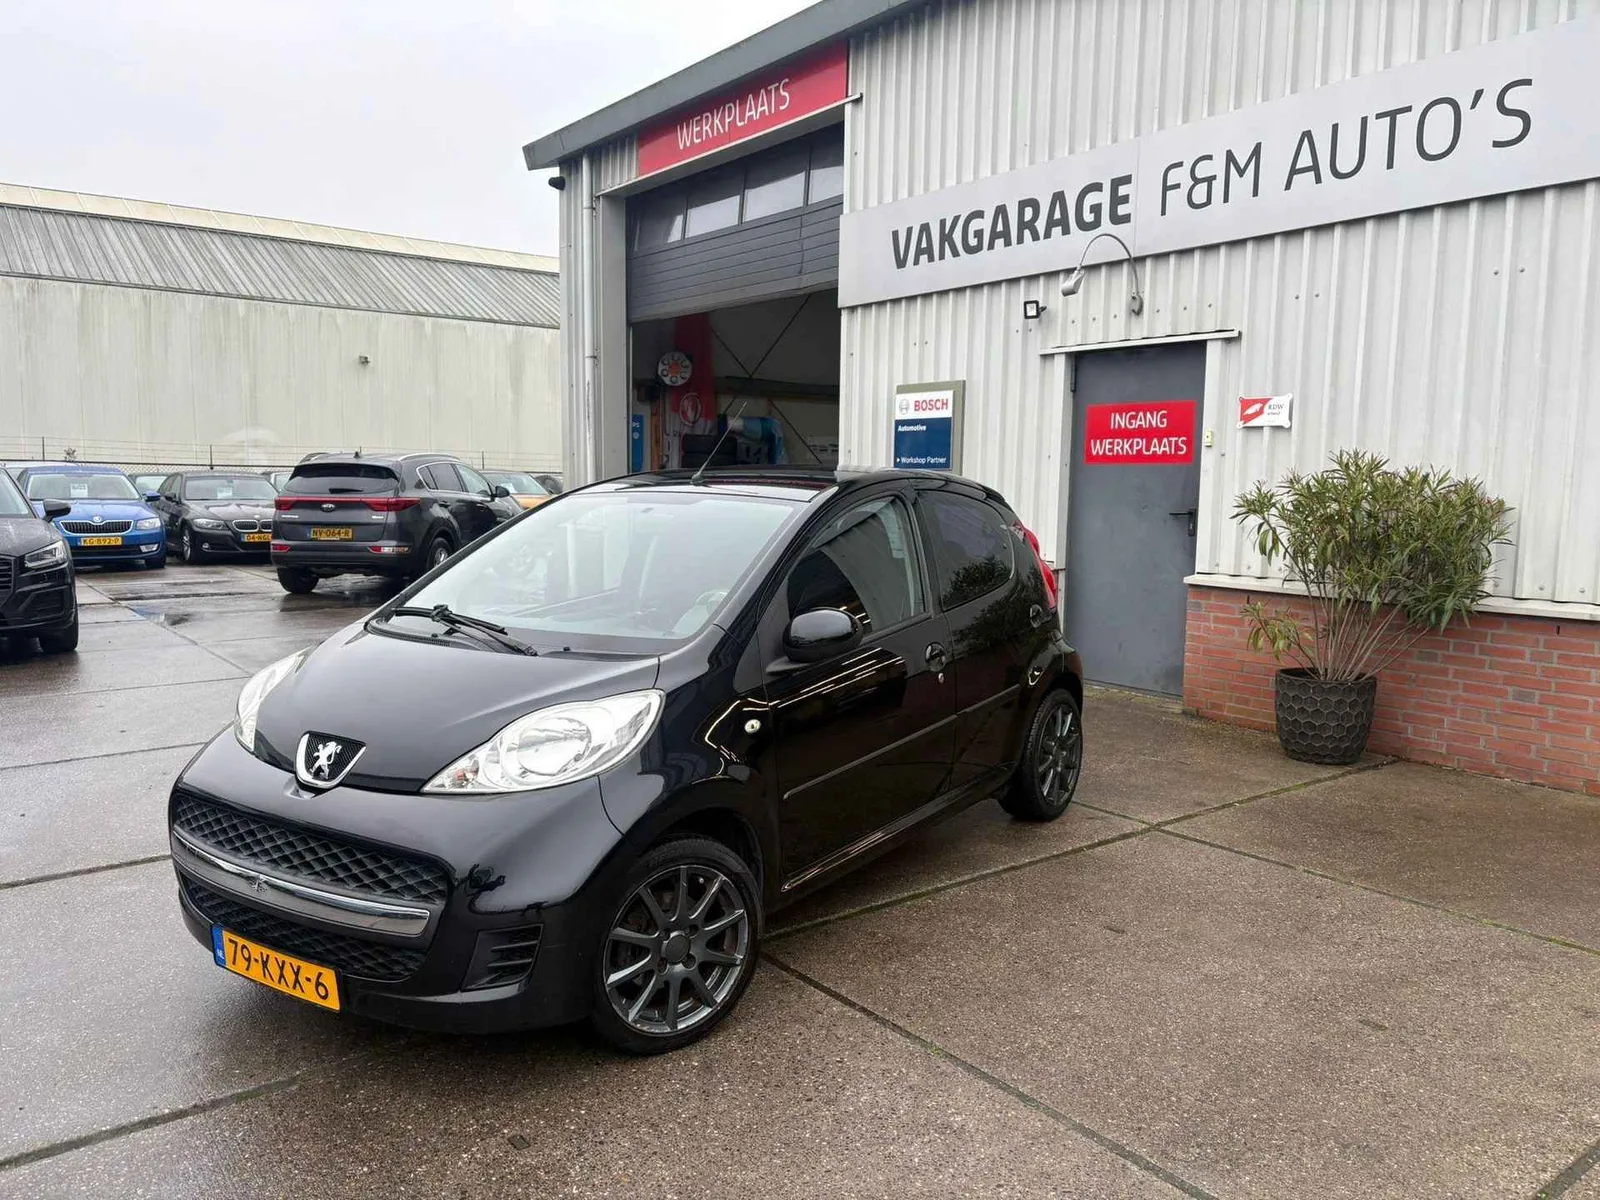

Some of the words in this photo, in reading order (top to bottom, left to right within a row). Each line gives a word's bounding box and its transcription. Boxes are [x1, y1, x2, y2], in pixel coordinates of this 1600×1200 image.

[677, 78, 790, 150] WERKPLAATS
[891, 173, 1133, 270] VAKGARAGE
[1160, 141, 1262, 217] F&M
[1284, 78, 1533, 193] AUTO'S
[914, 398, 949, 412] BOSCH
[897, 424, 926, 432] Automotive
[1110, 410, 1168, 429] INGANG
[1090, 436, 1187, 456] WERKPLAATS
[312, 529, 351, 537] NV-064-R
[228, 938, 329, 1000] 79-KXX-6
